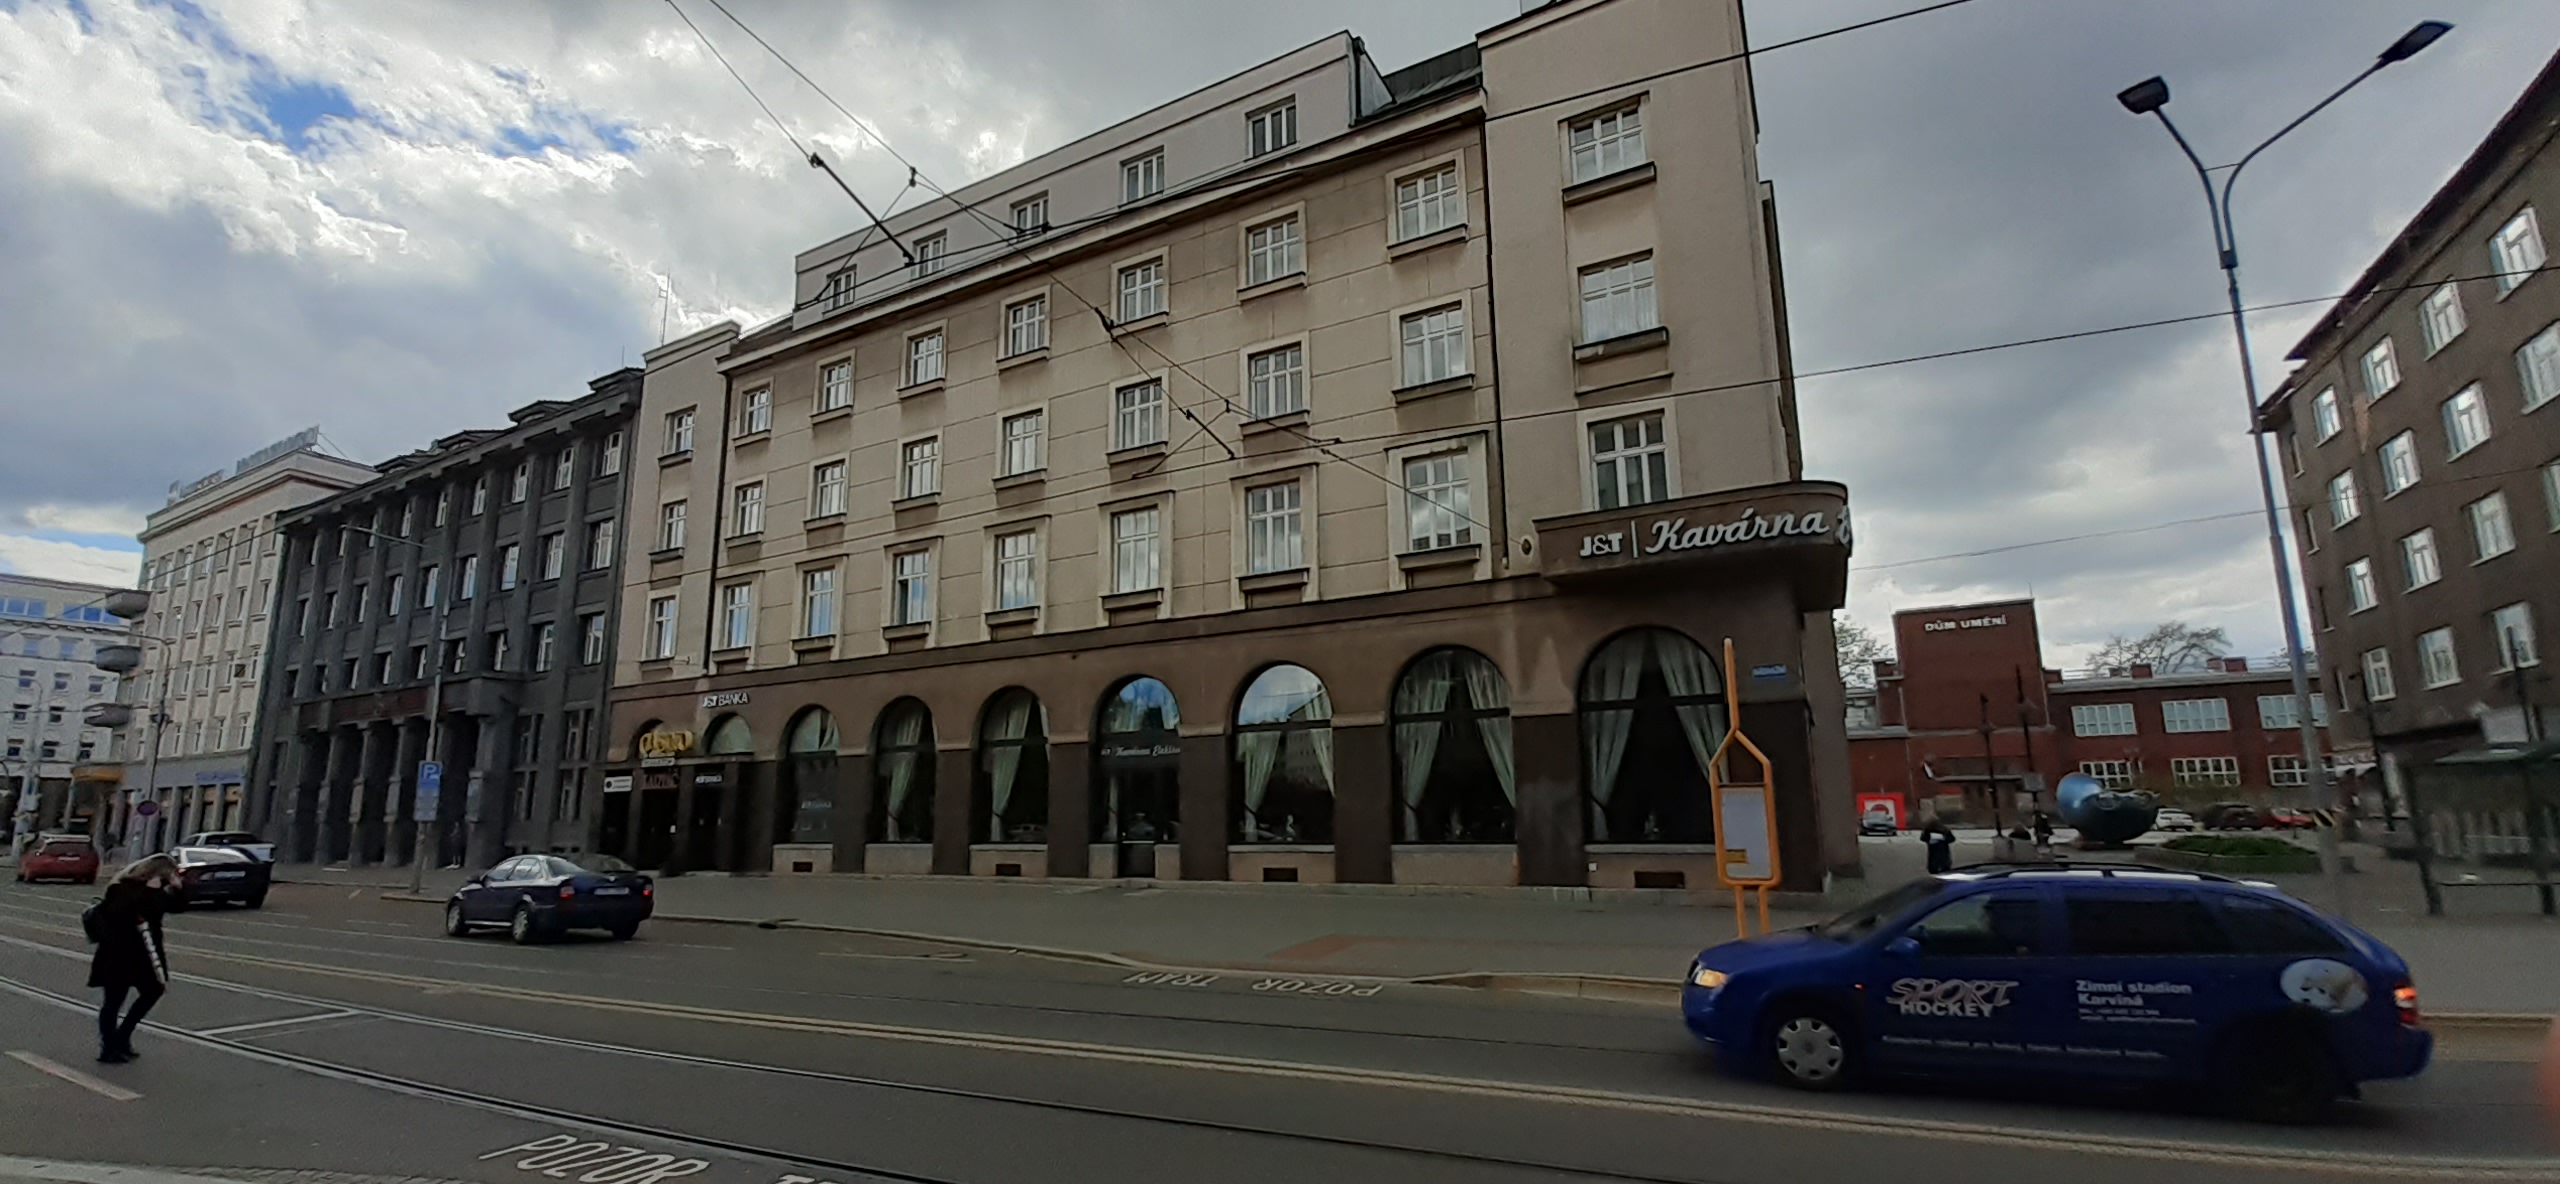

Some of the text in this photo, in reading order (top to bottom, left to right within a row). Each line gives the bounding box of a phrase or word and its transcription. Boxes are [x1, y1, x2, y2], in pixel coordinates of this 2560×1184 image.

[1580, 533, 1623, 557] J&T
[1646, 508, 1830, 553] Kavárna
[718, 692, 748, 706] BANKA
[1252, 977, 1384, 998] POZOR
[1886, 978, 2020, 1008] SPORT
[2127, 981, 2193, 995] stadion
[1899, 1002, 1996, 1018] HOCKEY
[478, 1134, 710, 1184] POZOR
